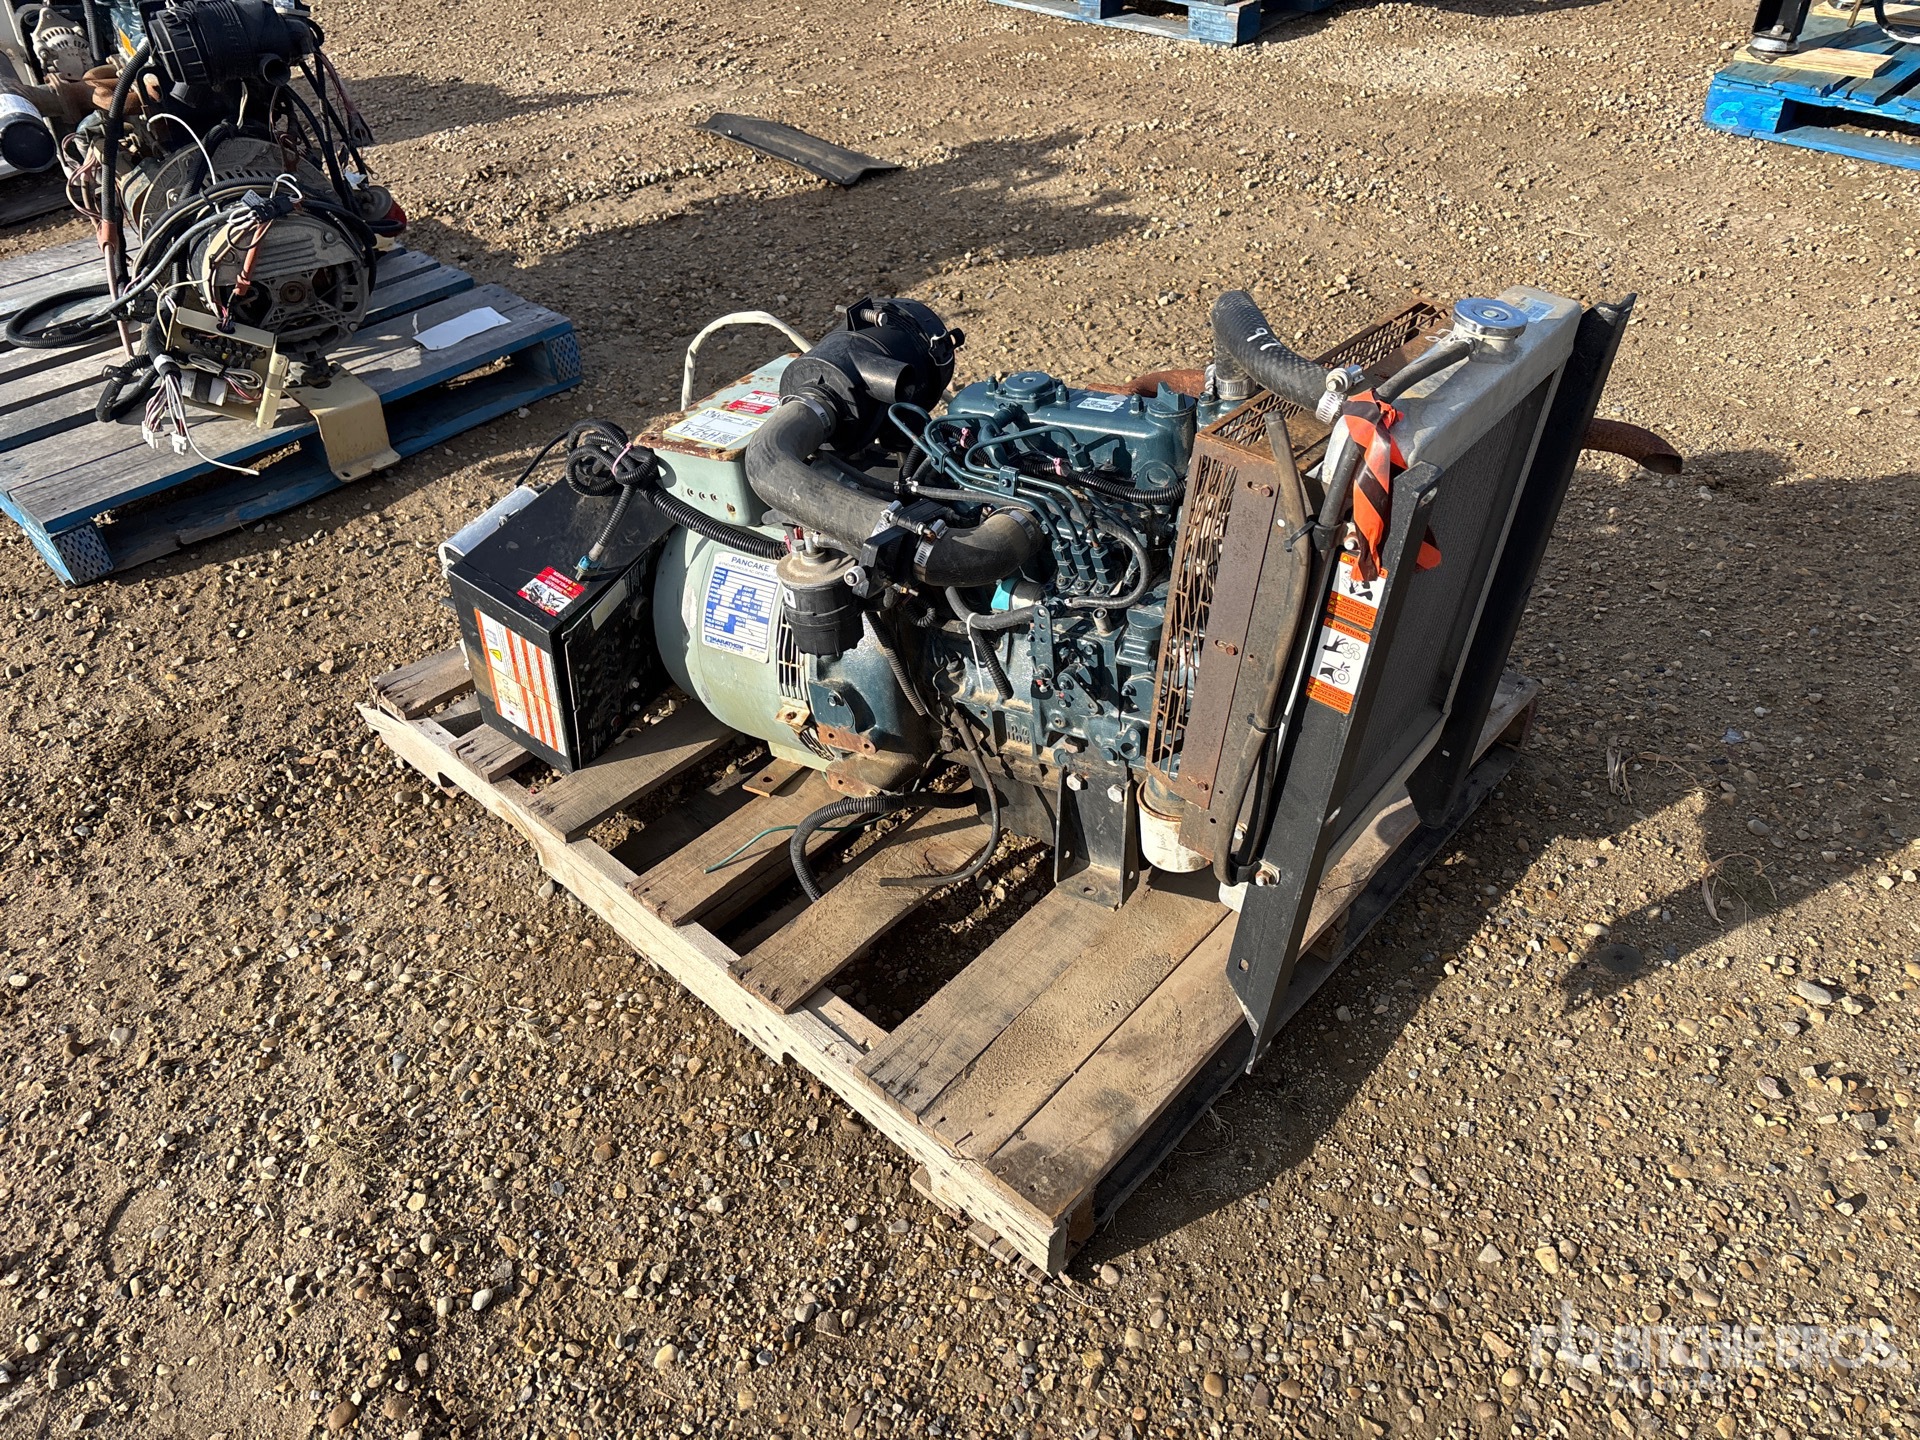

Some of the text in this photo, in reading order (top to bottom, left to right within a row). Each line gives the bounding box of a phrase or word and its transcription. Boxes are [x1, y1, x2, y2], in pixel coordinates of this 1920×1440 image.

[731, 556, 770, 572] PANCAKE
[1341, 597, 1371, 613] WARNUNG
[1335, 623, 1367, 641] WARNING
[1314, 686, 1350, 706] ADVERTENCIA
[1320, 682, 1348, 698] WARNUNG
